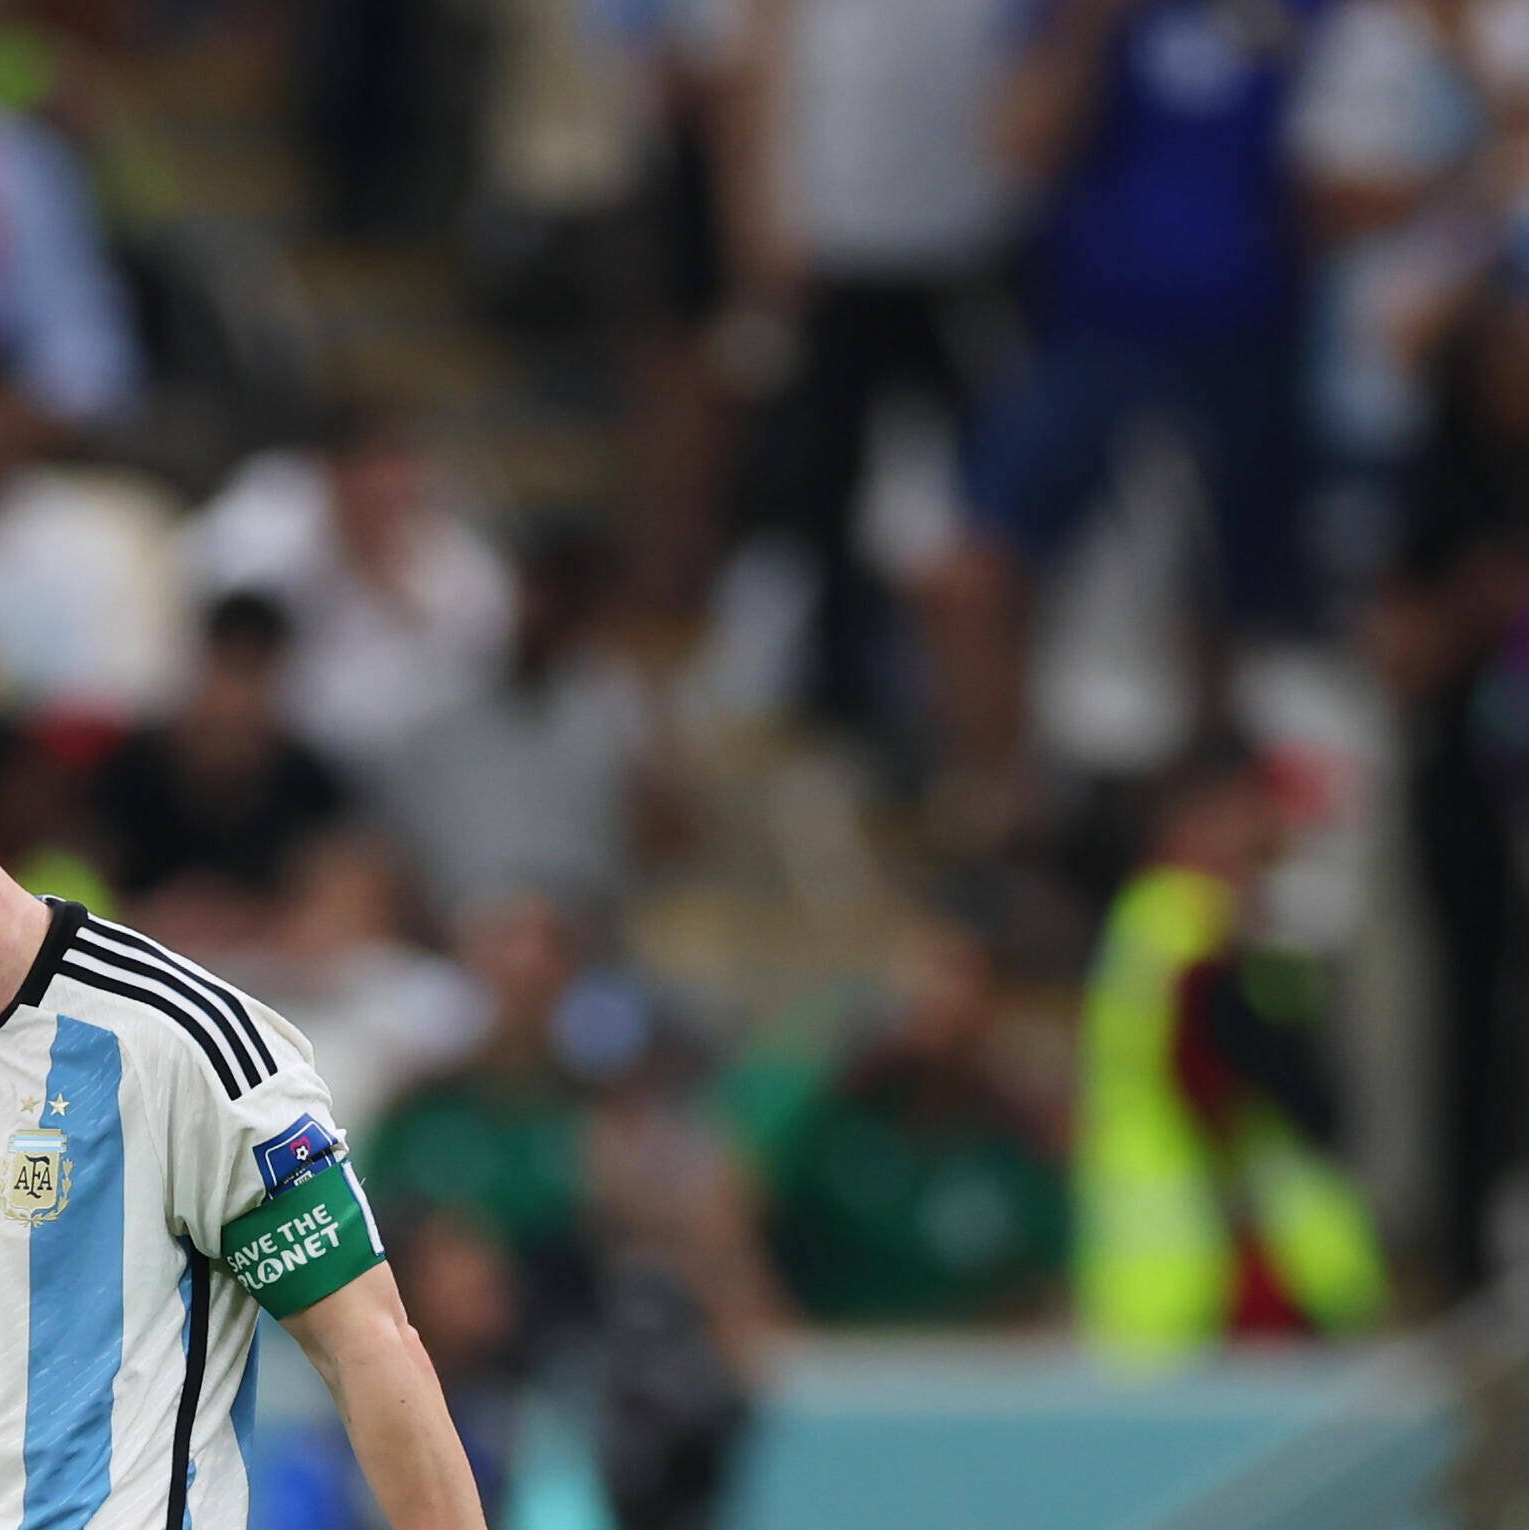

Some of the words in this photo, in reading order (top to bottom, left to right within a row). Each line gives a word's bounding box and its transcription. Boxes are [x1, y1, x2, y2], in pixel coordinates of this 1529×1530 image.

[13, 1154, 53, 1199] AFA
[226, 1232, 278, 1273] SAVE
[277, 1203, 333, 1243] THE
